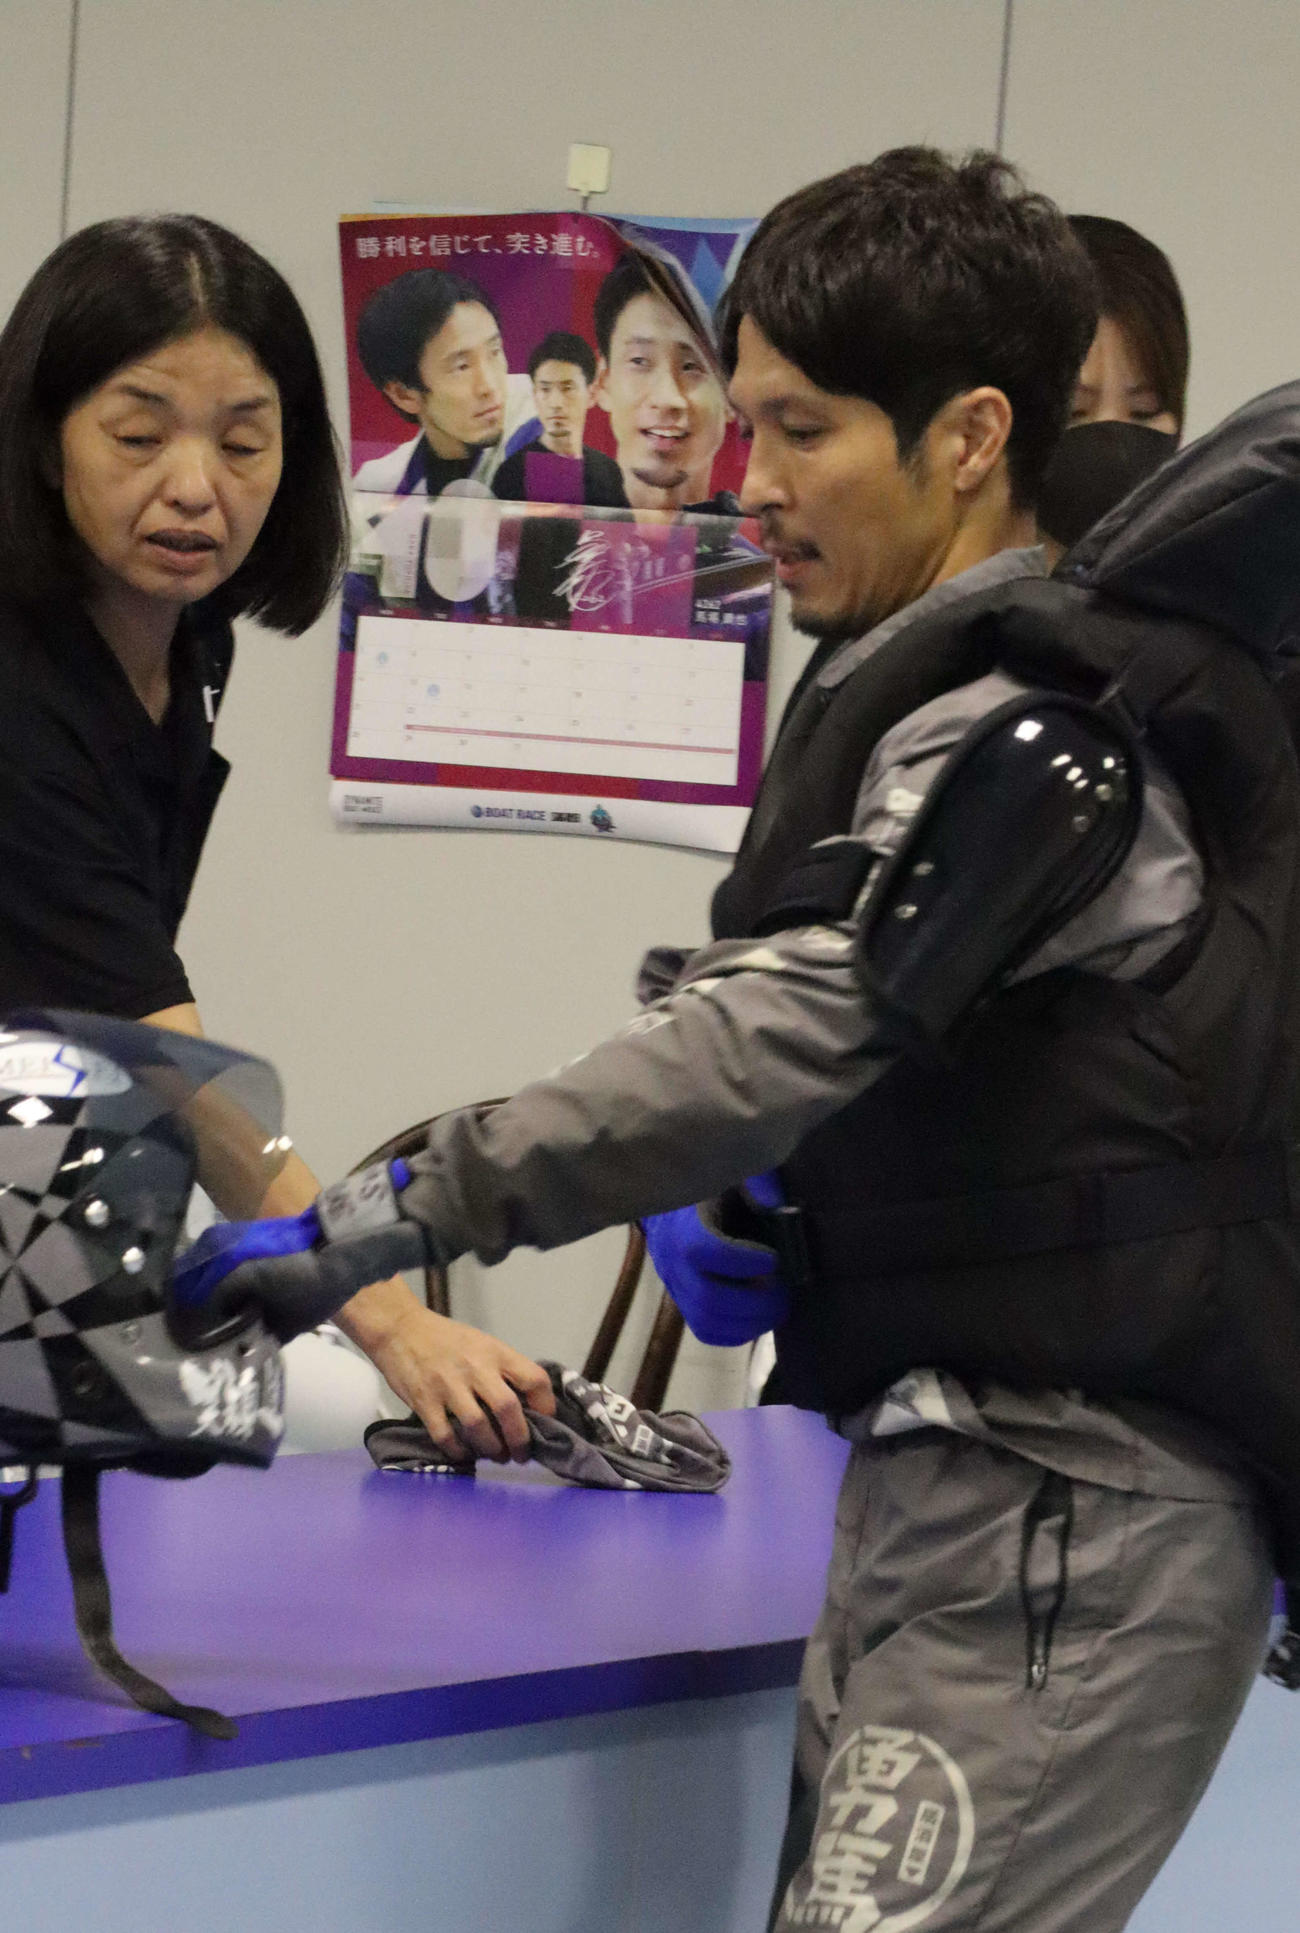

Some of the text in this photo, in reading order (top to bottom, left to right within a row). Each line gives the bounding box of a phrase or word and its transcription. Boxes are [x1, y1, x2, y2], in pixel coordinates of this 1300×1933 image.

[355, 232, 599, 259] 勝利を信じて、突き進む。
[485, 807, 513, 819] BOAT
[516, 809, 546, 821] RACE
